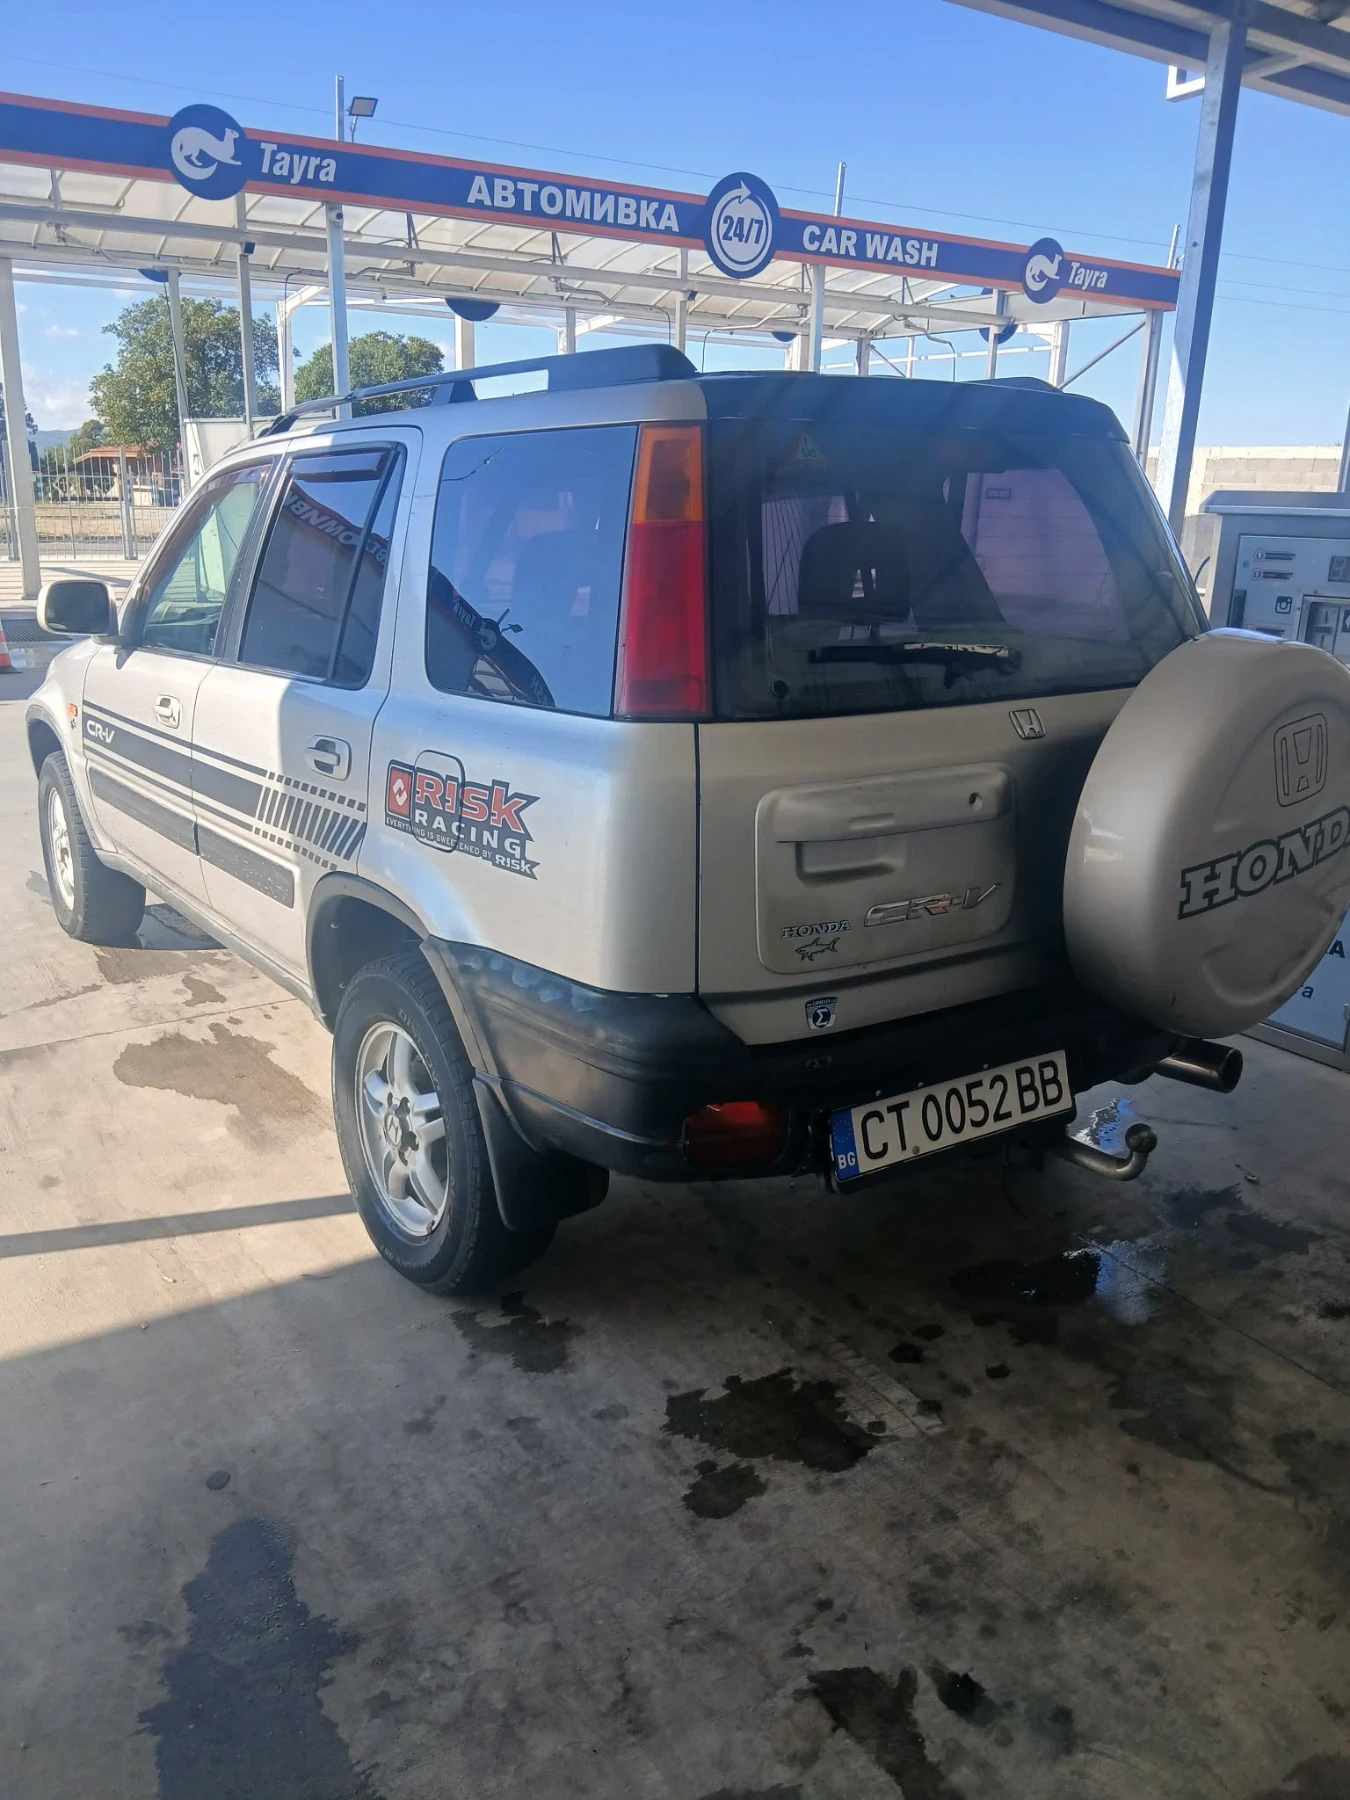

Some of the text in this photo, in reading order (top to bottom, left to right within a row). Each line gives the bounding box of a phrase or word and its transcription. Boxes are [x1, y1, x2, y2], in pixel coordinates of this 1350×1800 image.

[260, 142, 337, 185] Tayra
[467, 175, 680, 233] АВТОМИВКА
[722, 214, 764, 245] 24/7
[803, 224, 938, 267] CAR WASH
[1068, 261, 1108, 291] Tayra
[86, 719, 115, 744] CR-V
[414, 809, 522, 860] RACING
[482, 849, 493, 859] BY
[1178, 805, 1350, 920] HOND
[864, 883, 1002, 927] CR-V
[782, 920, 852, 939] HONDA
[838, 1060, 1064, 1170] BG CT 0052 BB
